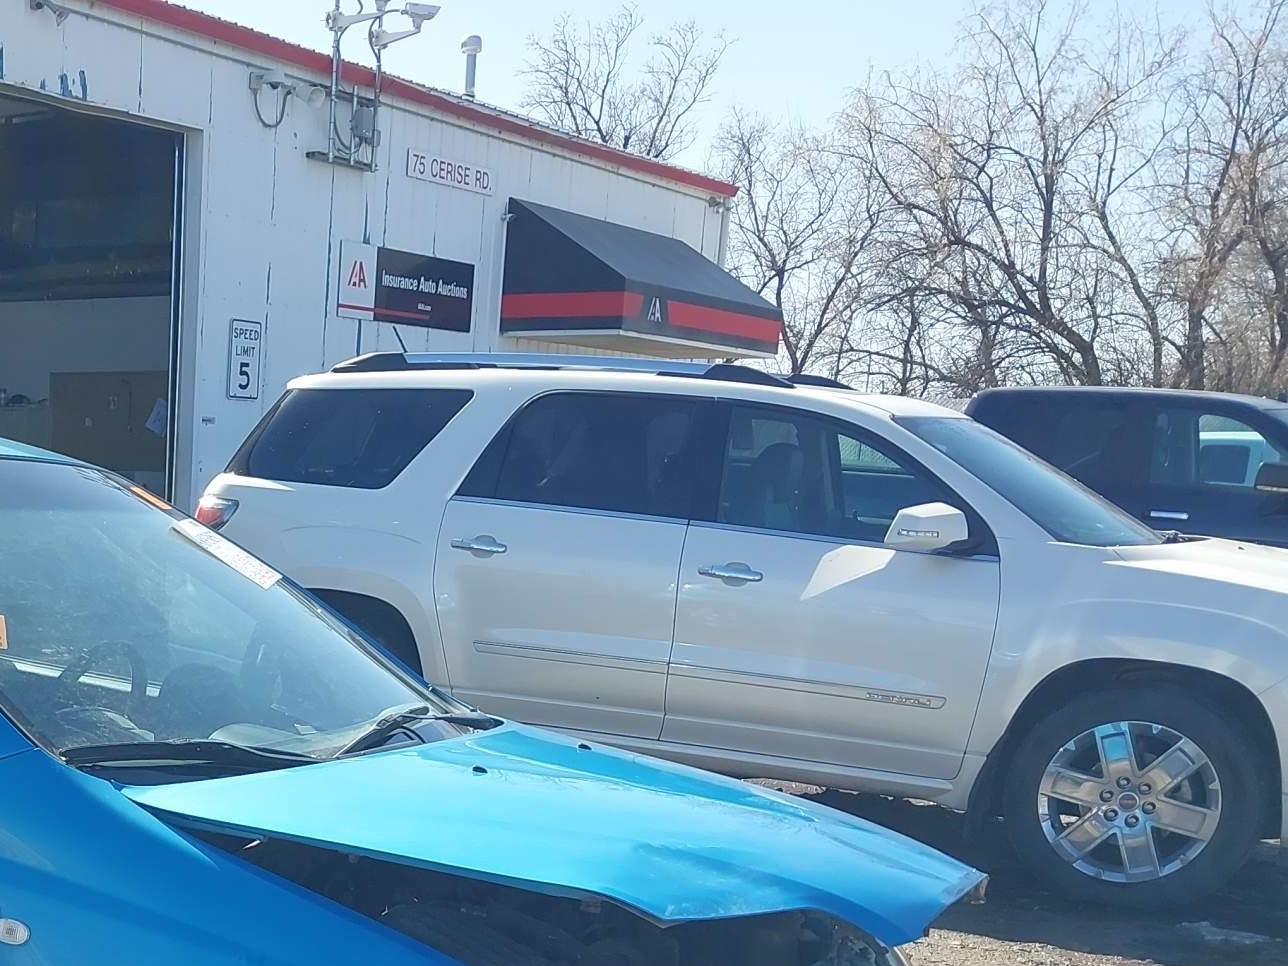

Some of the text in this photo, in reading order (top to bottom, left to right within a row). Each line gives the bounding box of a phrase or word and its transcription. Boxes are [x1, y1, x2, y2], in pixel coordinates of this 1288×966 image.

[412, 153, 492, 191] 75 CERISE RD.
[382, 270, 468, 299] Insurance Auto Auctions
[233, 327, 259, 341] SPEED
[235, 344, 256, 358] LIMIT
[238, 362, 250, 390] 5
